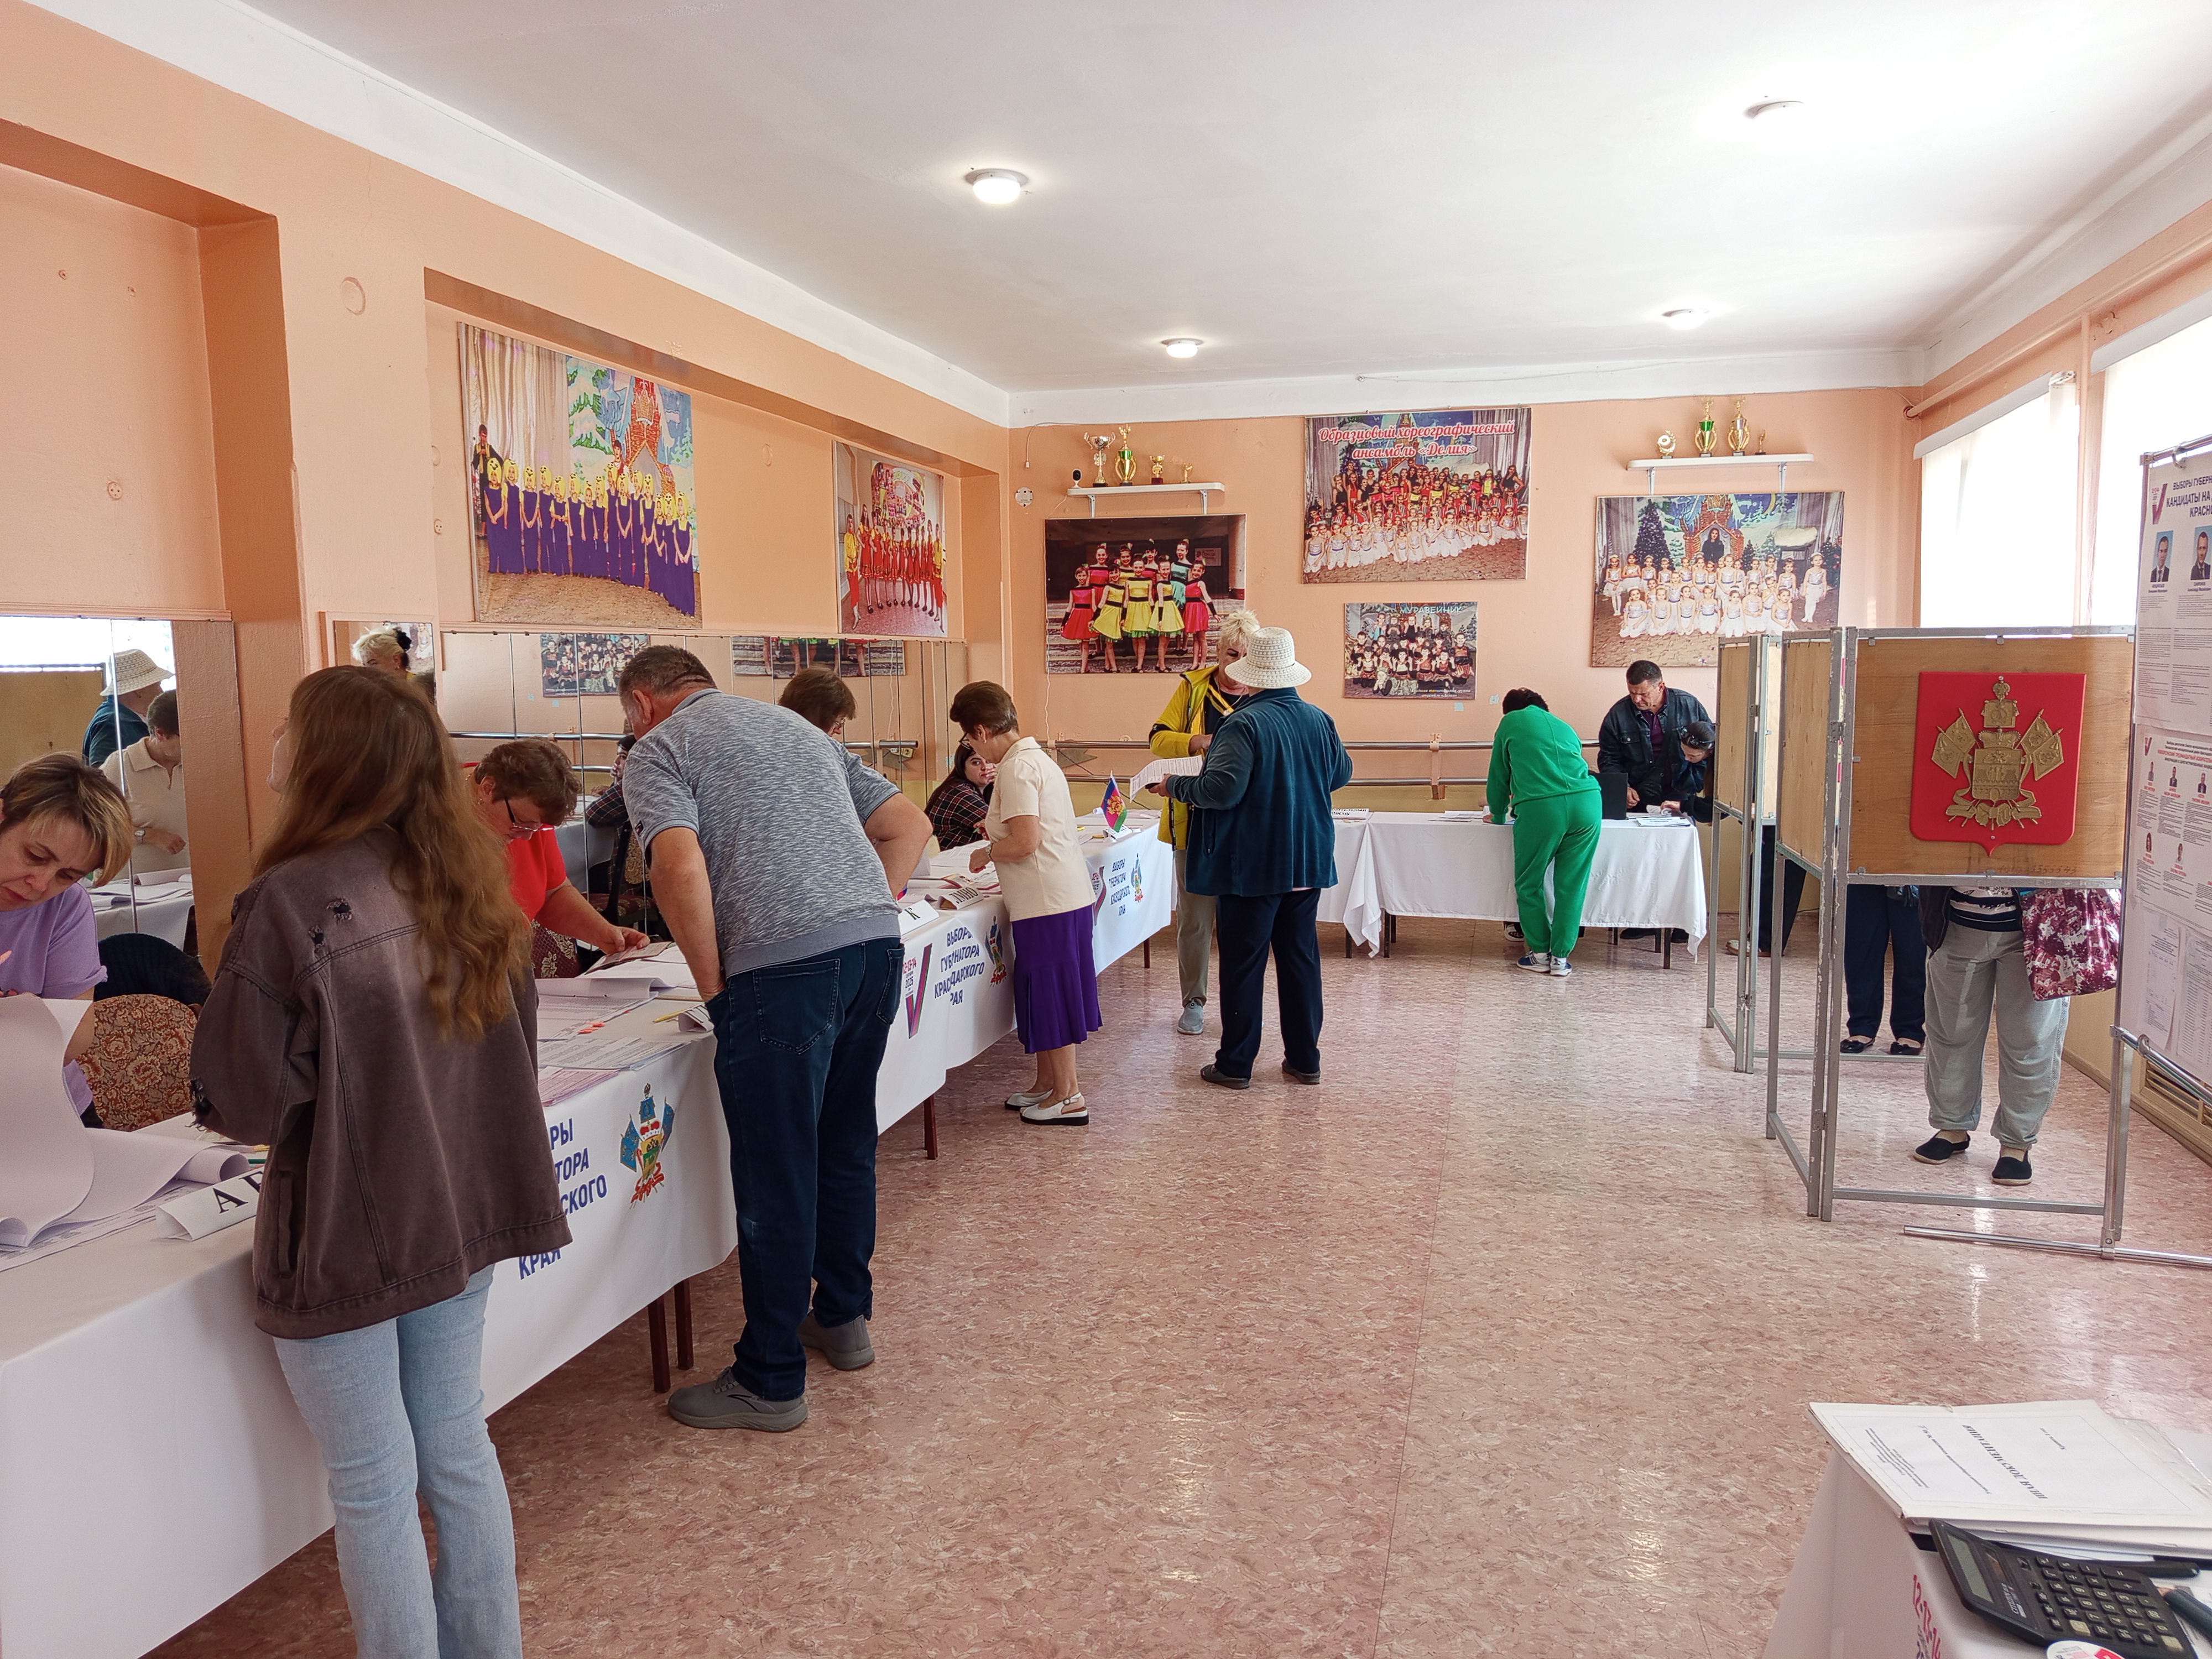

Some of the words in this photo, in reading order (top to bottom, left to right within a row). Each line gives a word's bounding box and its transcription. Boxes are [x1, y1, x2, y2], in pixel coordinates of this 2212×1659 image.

[1319, 425, 1397, 445] Образцовый
[1397, 420, 1516, 441] хореографический
[1353, 444, 1417, 459] ансамбль
[1418, 443, 1477, 457] «Делия»
[2173, 479, 2193, 491] ВЫБОРЫ
[2166, 492, 2200, 507] КАНДИДАТЫ
[2201, 491, 2210, 502] НА
[1400, 606, 1463, 614] МУРАВЕЙНИК
